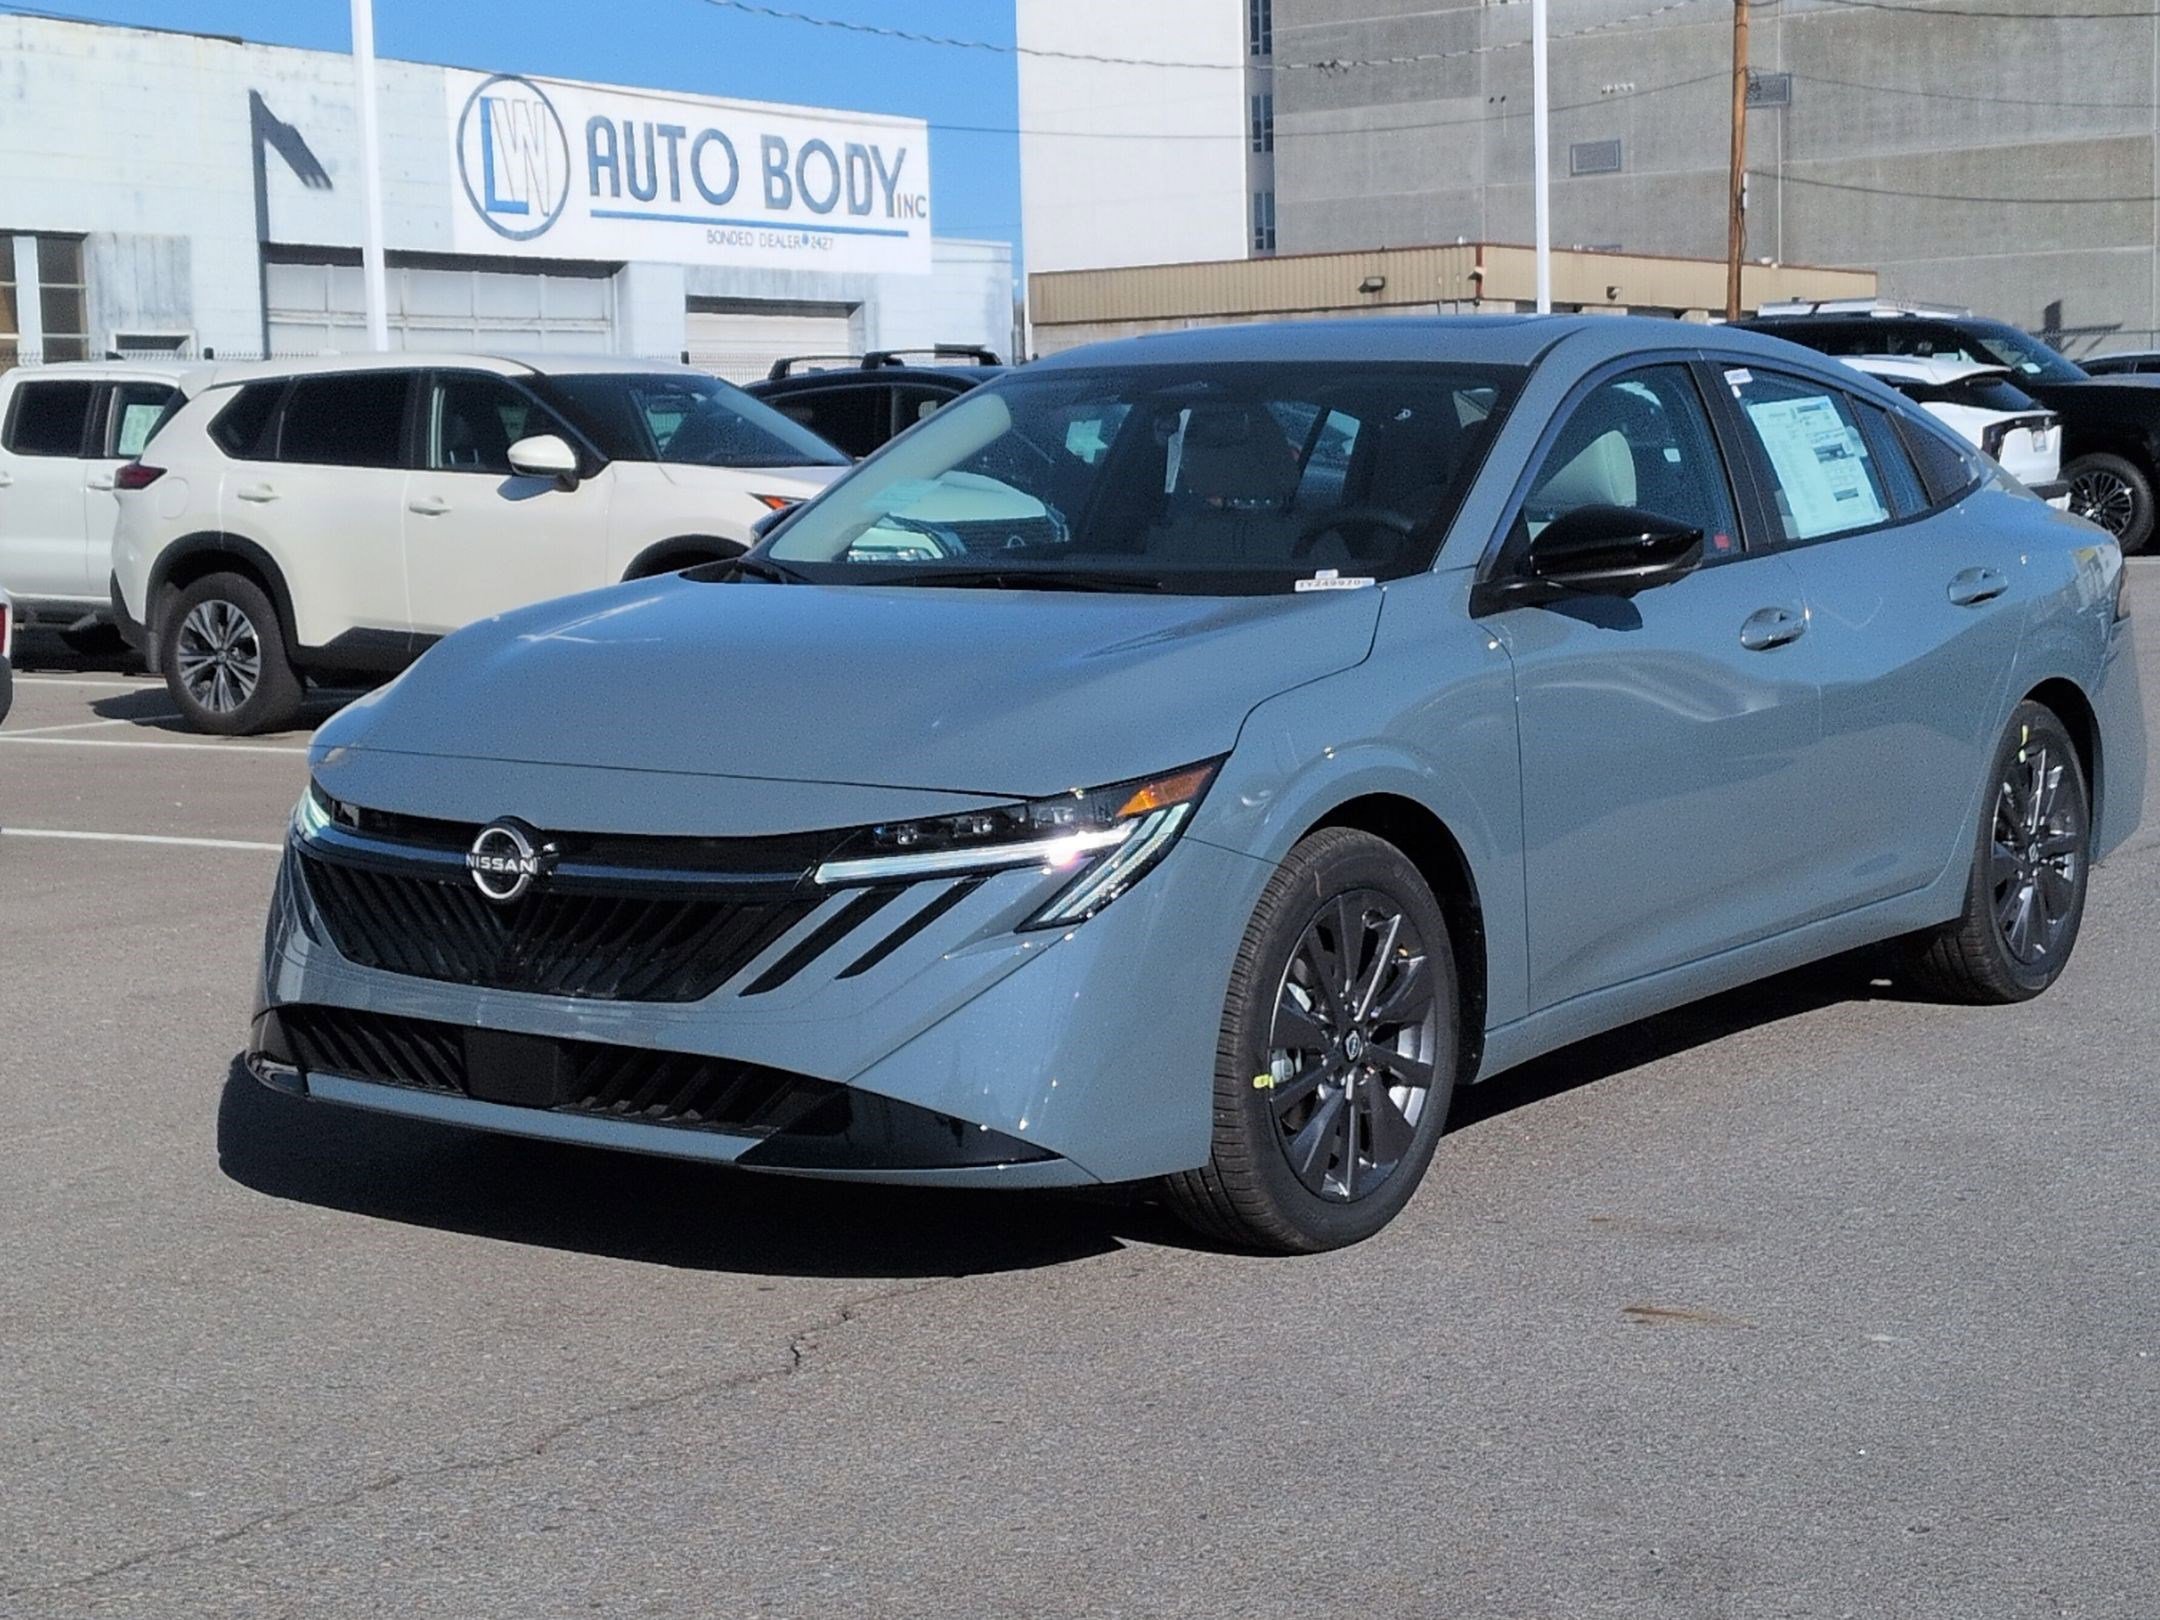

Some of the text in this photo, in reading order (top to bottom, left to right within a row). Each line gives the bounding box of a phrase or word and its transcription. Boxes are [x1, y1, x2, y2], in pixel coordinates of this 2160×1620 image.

[586, 114, 928, 219] AUTO BODY INC
[706, 228, 754, 247] BONDED
[465, 852, 536, 874] NISSAN
